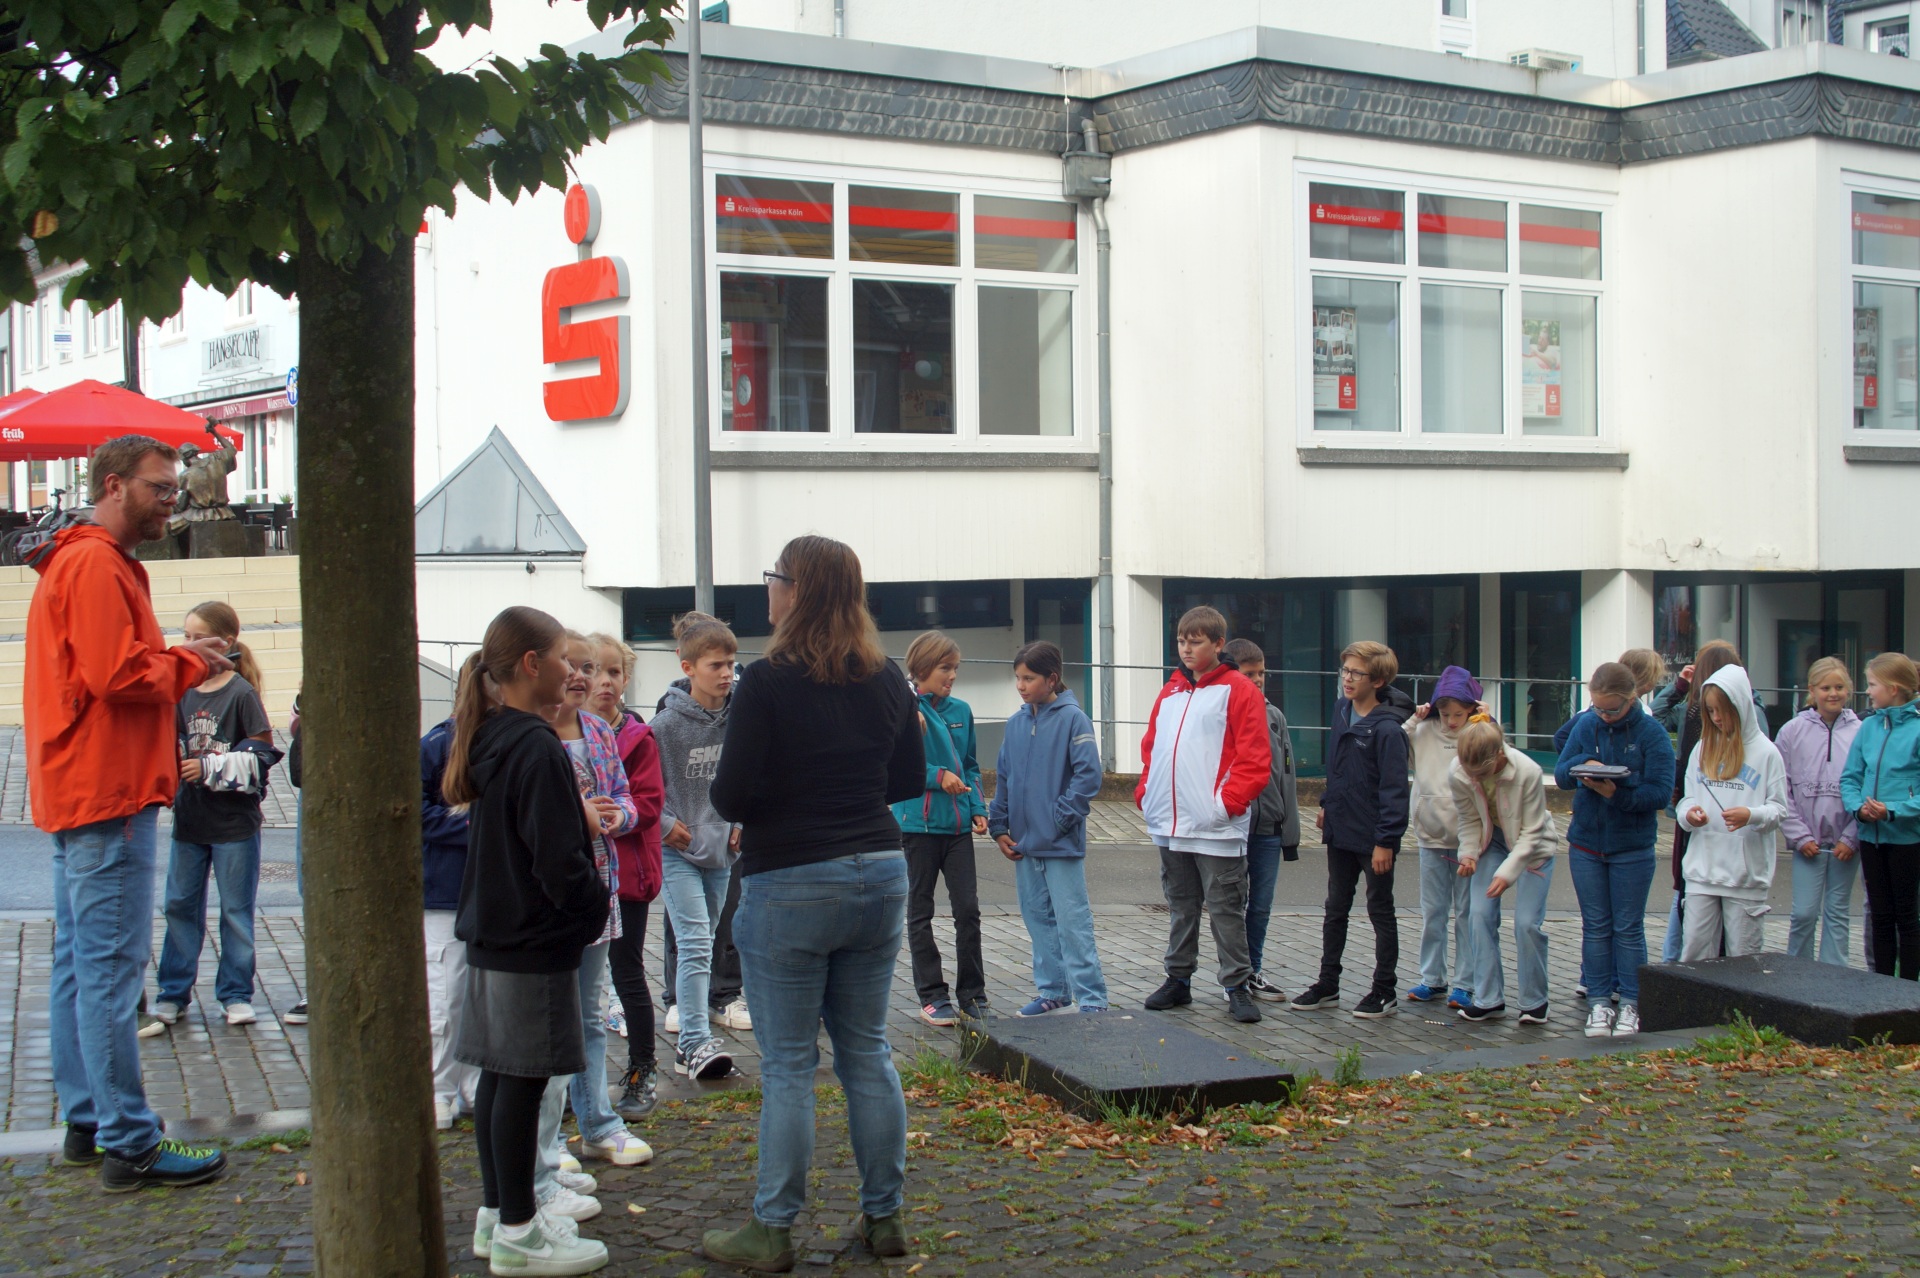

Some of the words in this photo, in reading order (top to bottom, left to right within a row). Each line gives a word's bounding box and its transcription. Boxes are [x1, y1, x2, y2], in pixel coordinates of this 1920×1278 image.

[738, 205, 787, 215] Kreissparkasse
[788, 208, 803, 216] Köln
[1327, 212, 1367, 222] Kreissparkasse
[1368, 215, 1381, 223] Köln
[1725, 781, 1745, 791] STATES
